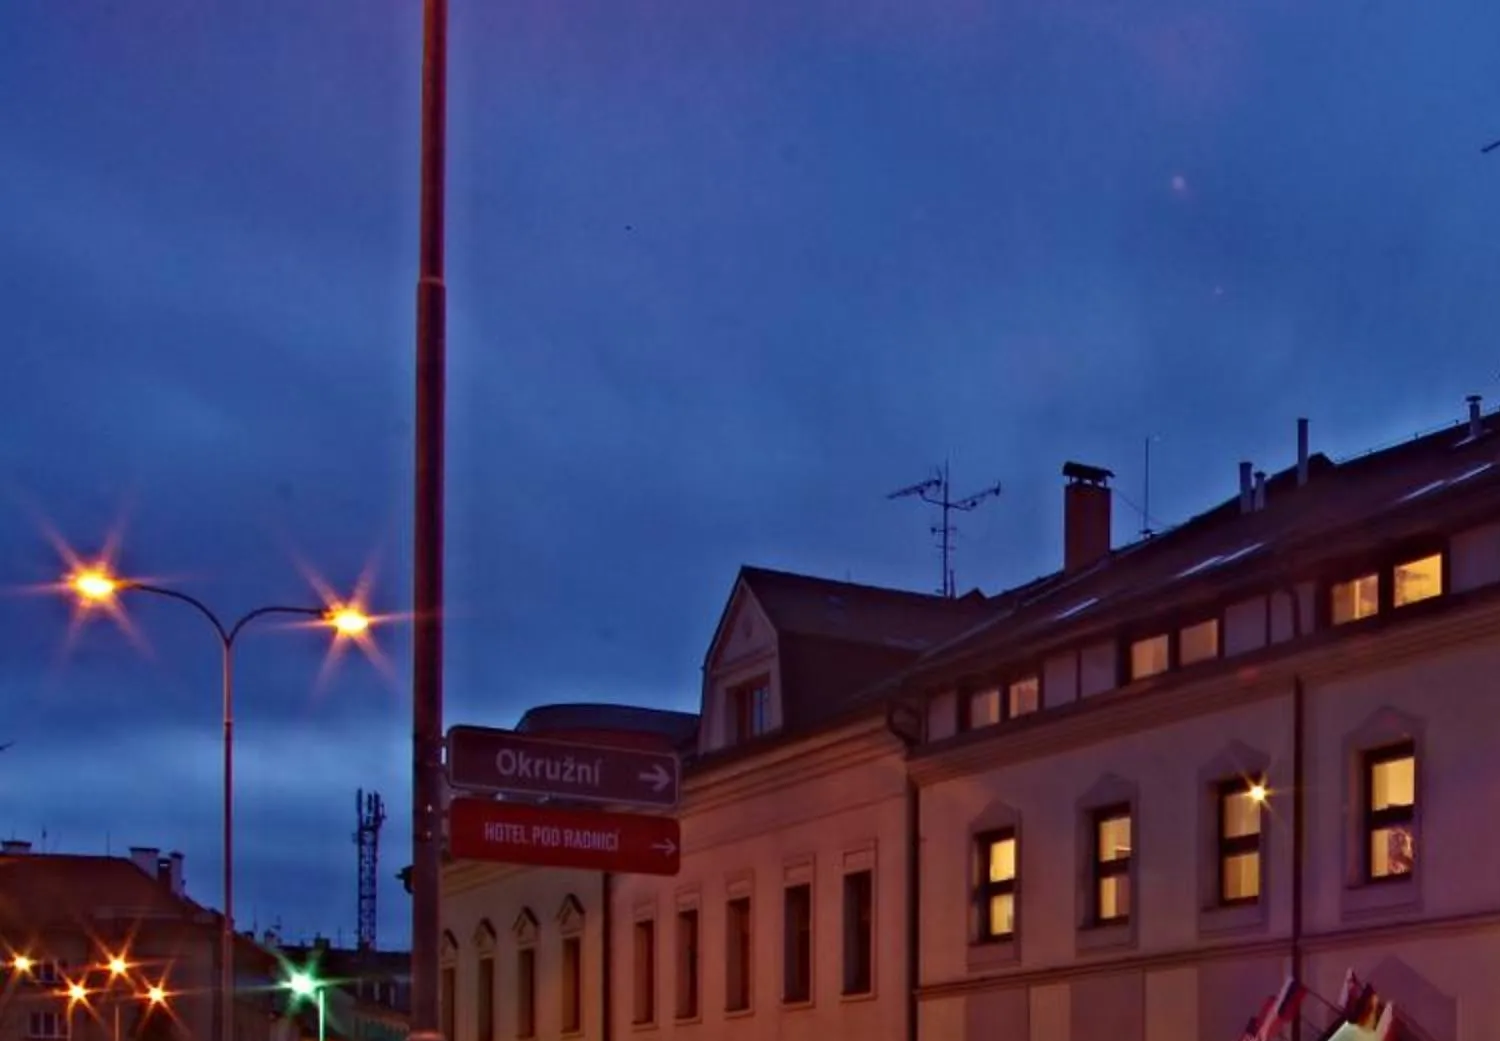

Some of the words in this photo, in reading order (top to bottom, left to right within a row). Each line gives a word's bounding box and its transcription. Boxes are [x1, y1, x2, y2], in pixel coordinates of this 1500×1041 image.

[496, 749, 602, 785] Okružní
[485, 822, 529, 844] HOTEL
[532, 825, 561, 848] POD
